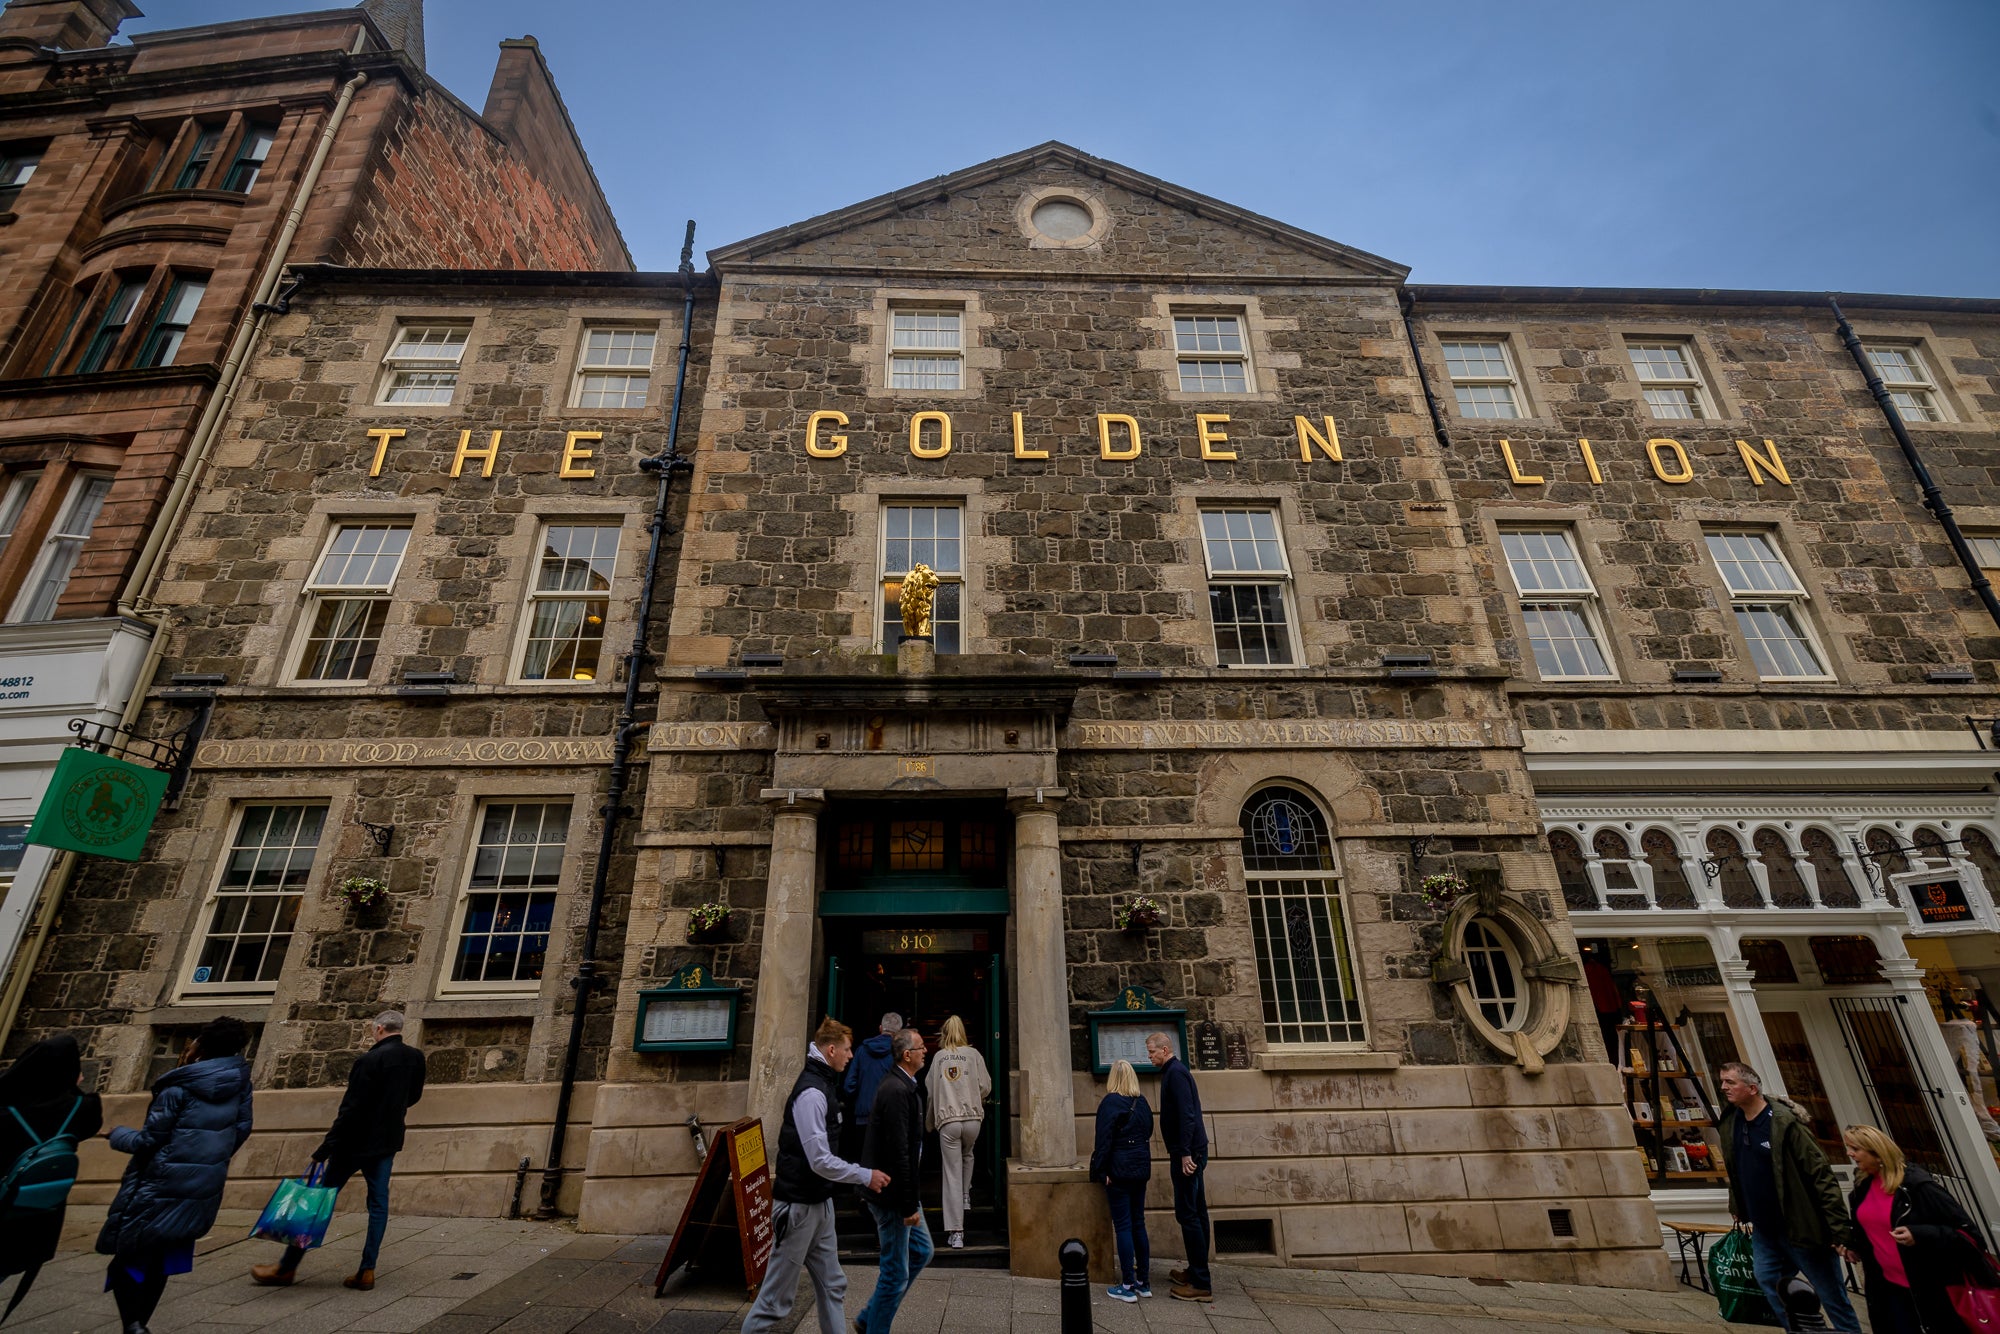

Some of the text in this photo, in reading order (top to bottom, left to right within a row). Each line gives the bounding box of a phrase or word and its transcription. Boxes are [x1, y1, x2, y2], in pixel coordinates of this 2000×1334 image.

[366, 410, 1792, 485] THE GOLDEN LION
[1081, 724, 1144, 744] FINE
[1261, 724, 1334, 744] ALES
[1369, 722, 1473, 743] SPIRITS
[198, 743, 330, 766] QUALITY
[340, 742, 419, 764] FOOD
[422, 744, 452, 758] and
[1922, 905, 1966, 915] STIRLING
[1933, 913, 1960, 921] COFFEE
[901, 935, 932, 949] 8-10
[1716, 1265, 1741, 1278] can
